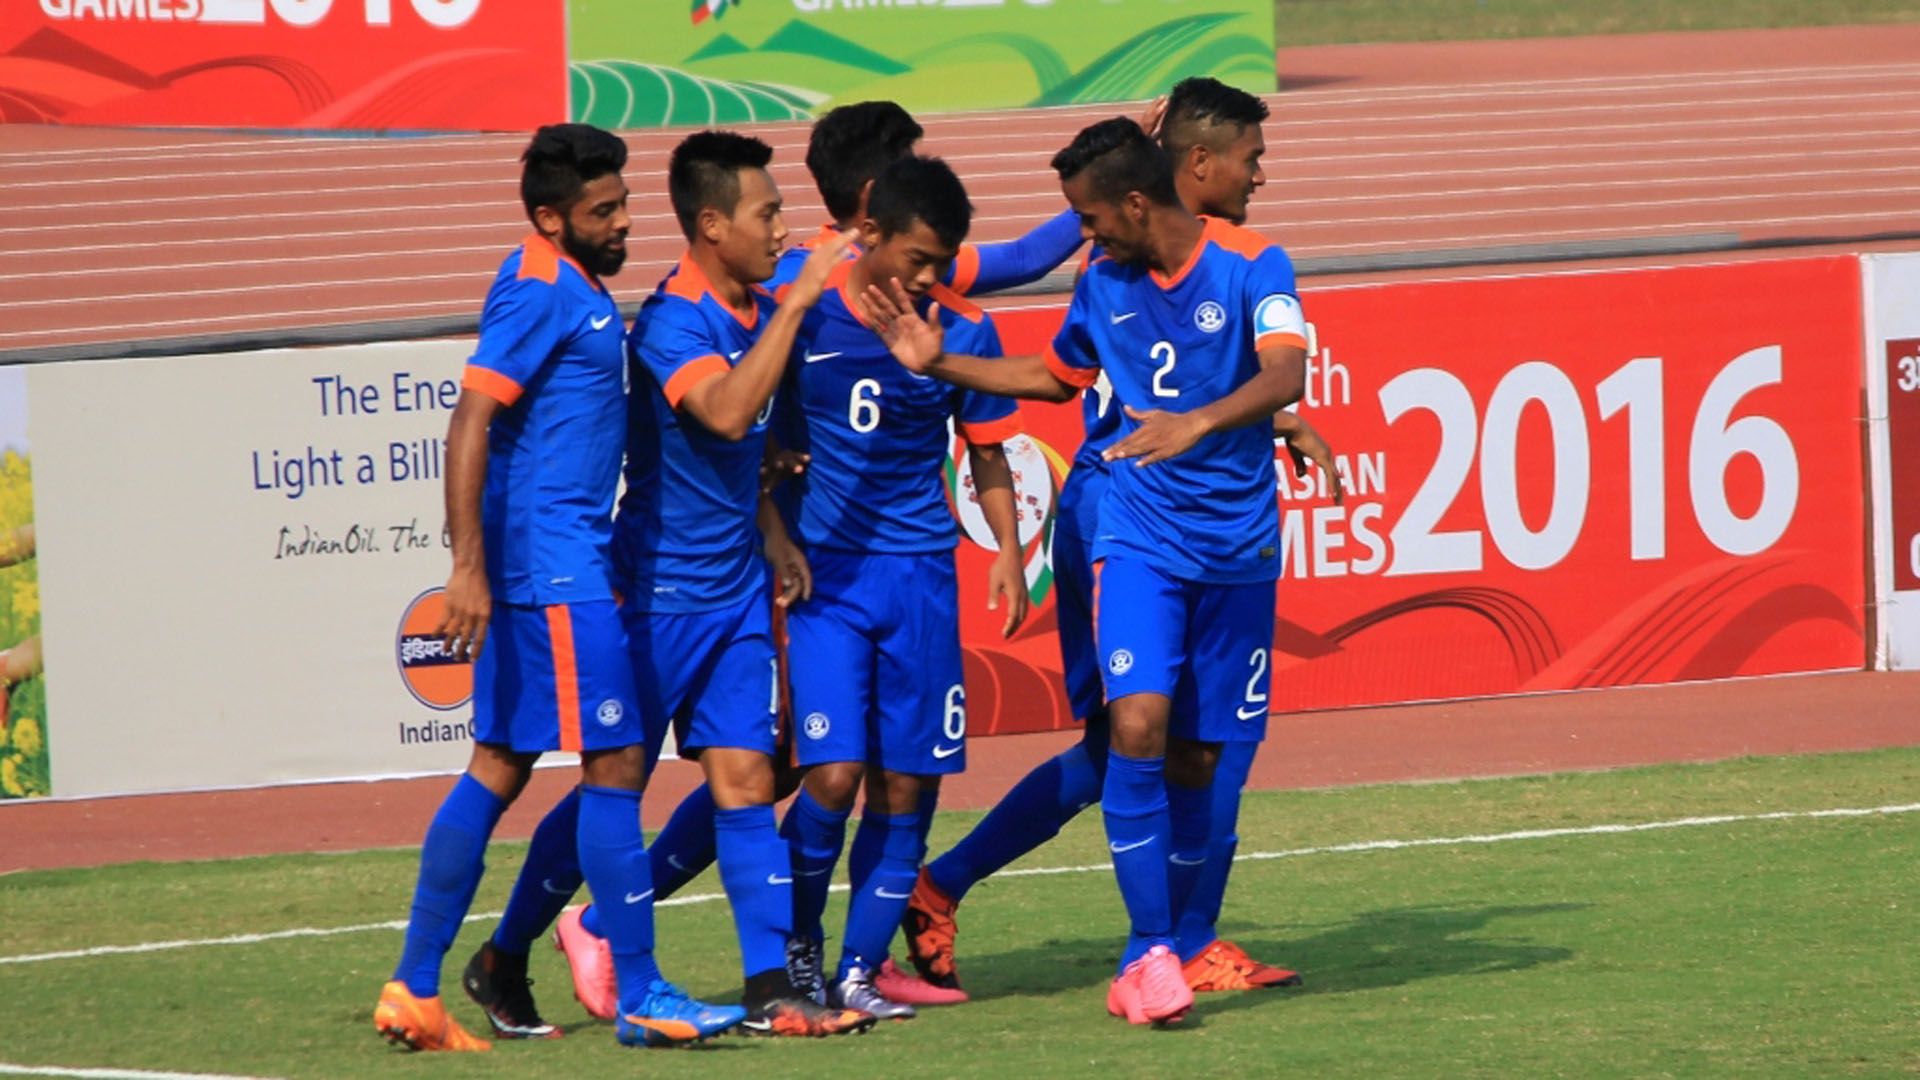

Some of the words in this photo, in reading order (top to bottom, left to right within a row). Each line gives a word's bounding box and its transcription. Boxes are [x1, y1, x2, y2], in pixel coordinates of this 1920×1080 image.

[312, 375, 379, 416] The
[393, 373, 458, 412] Ene
[1150, 341, 1180, 397] 2
[1284, 347, 1351, 413] th
[849, 378, 882, 433] 6
[252, 446, 344, 499] Light
[357, 454, 375, 484] a
[1378, 344, 1800, 577] 2016
[388, 517, 430, 552] The
[1245, 647, 1267, 702] 2
[943, 684, 966, 740] 6
